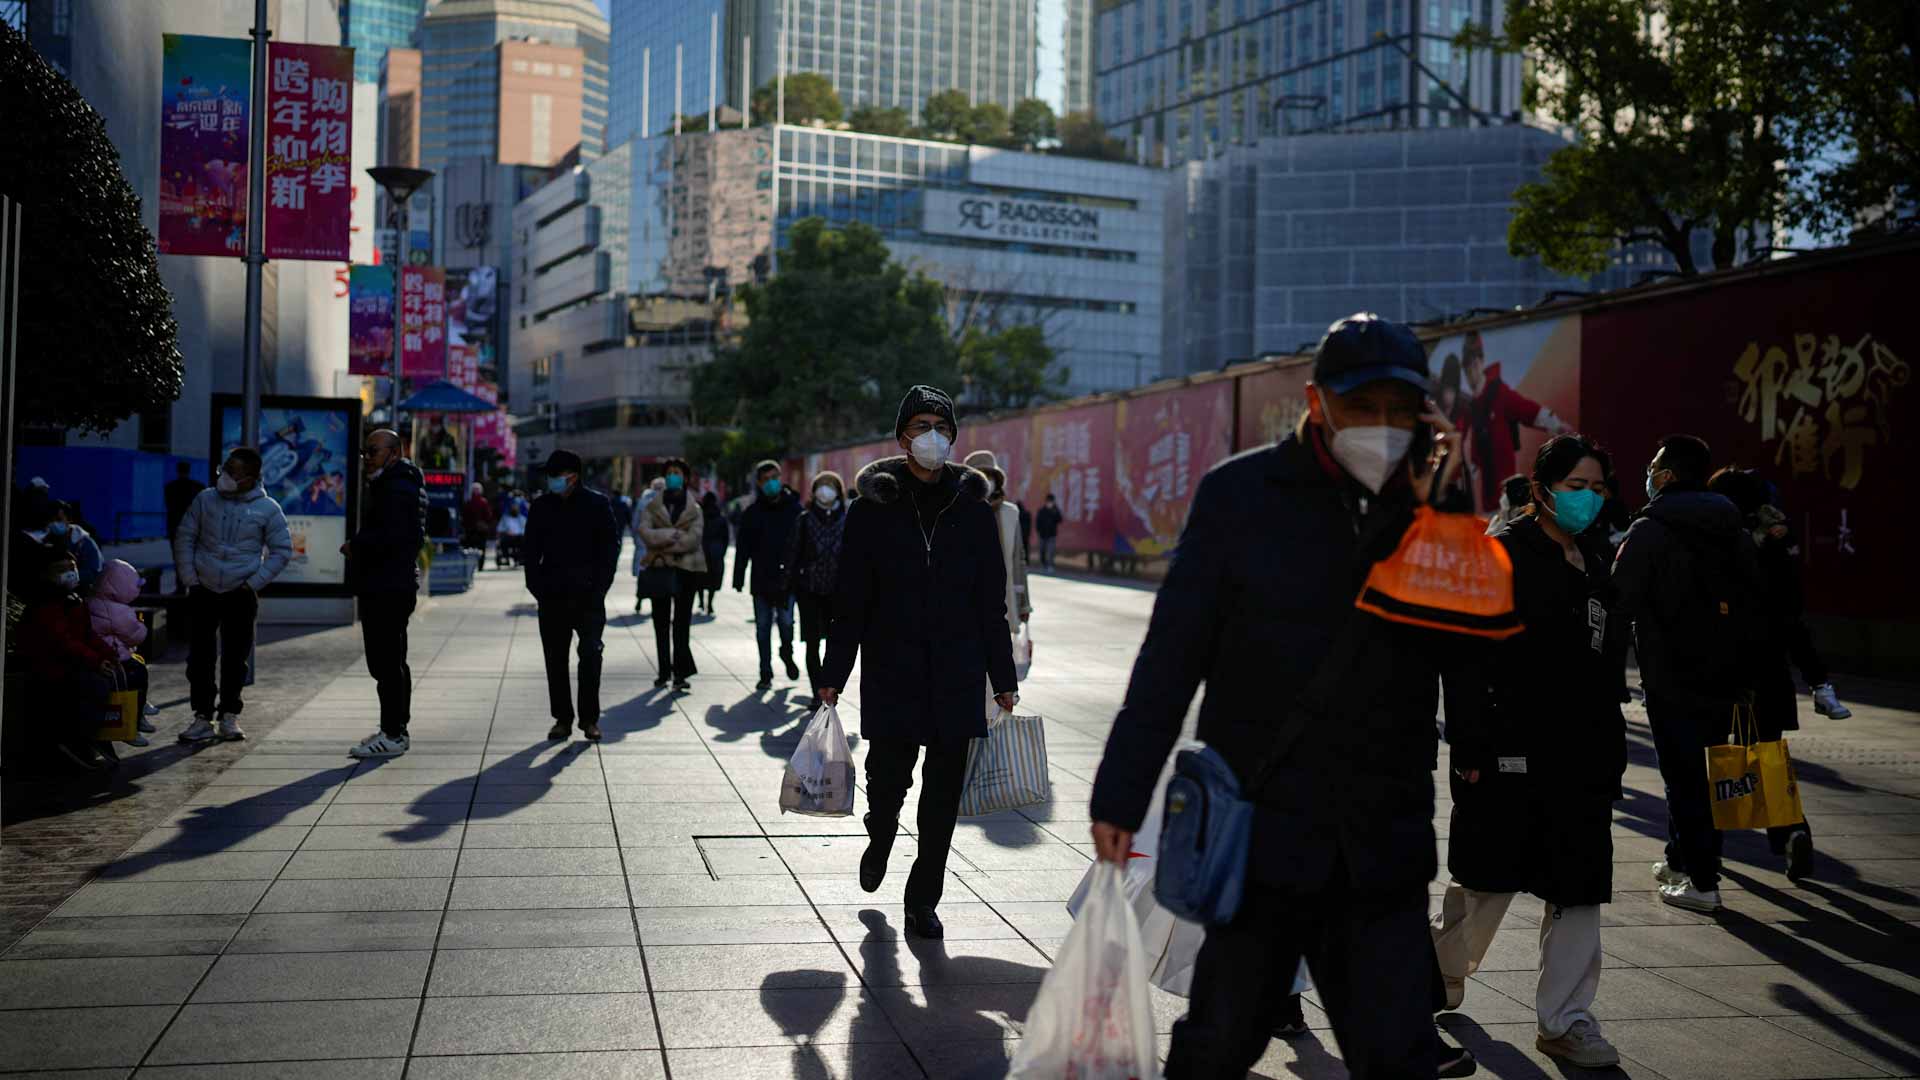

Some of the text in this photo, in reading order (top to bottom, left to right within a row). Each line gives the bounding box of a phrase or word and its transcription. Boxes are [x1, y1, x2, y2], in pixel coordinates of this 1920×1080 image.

[271, 56, 310, 210] 跨年迎新
[311, 77, 348, 194] 购物季
[999, 201, 1098, 227] RADISSON
[999, 226, 1098, 241] COLLECTION
